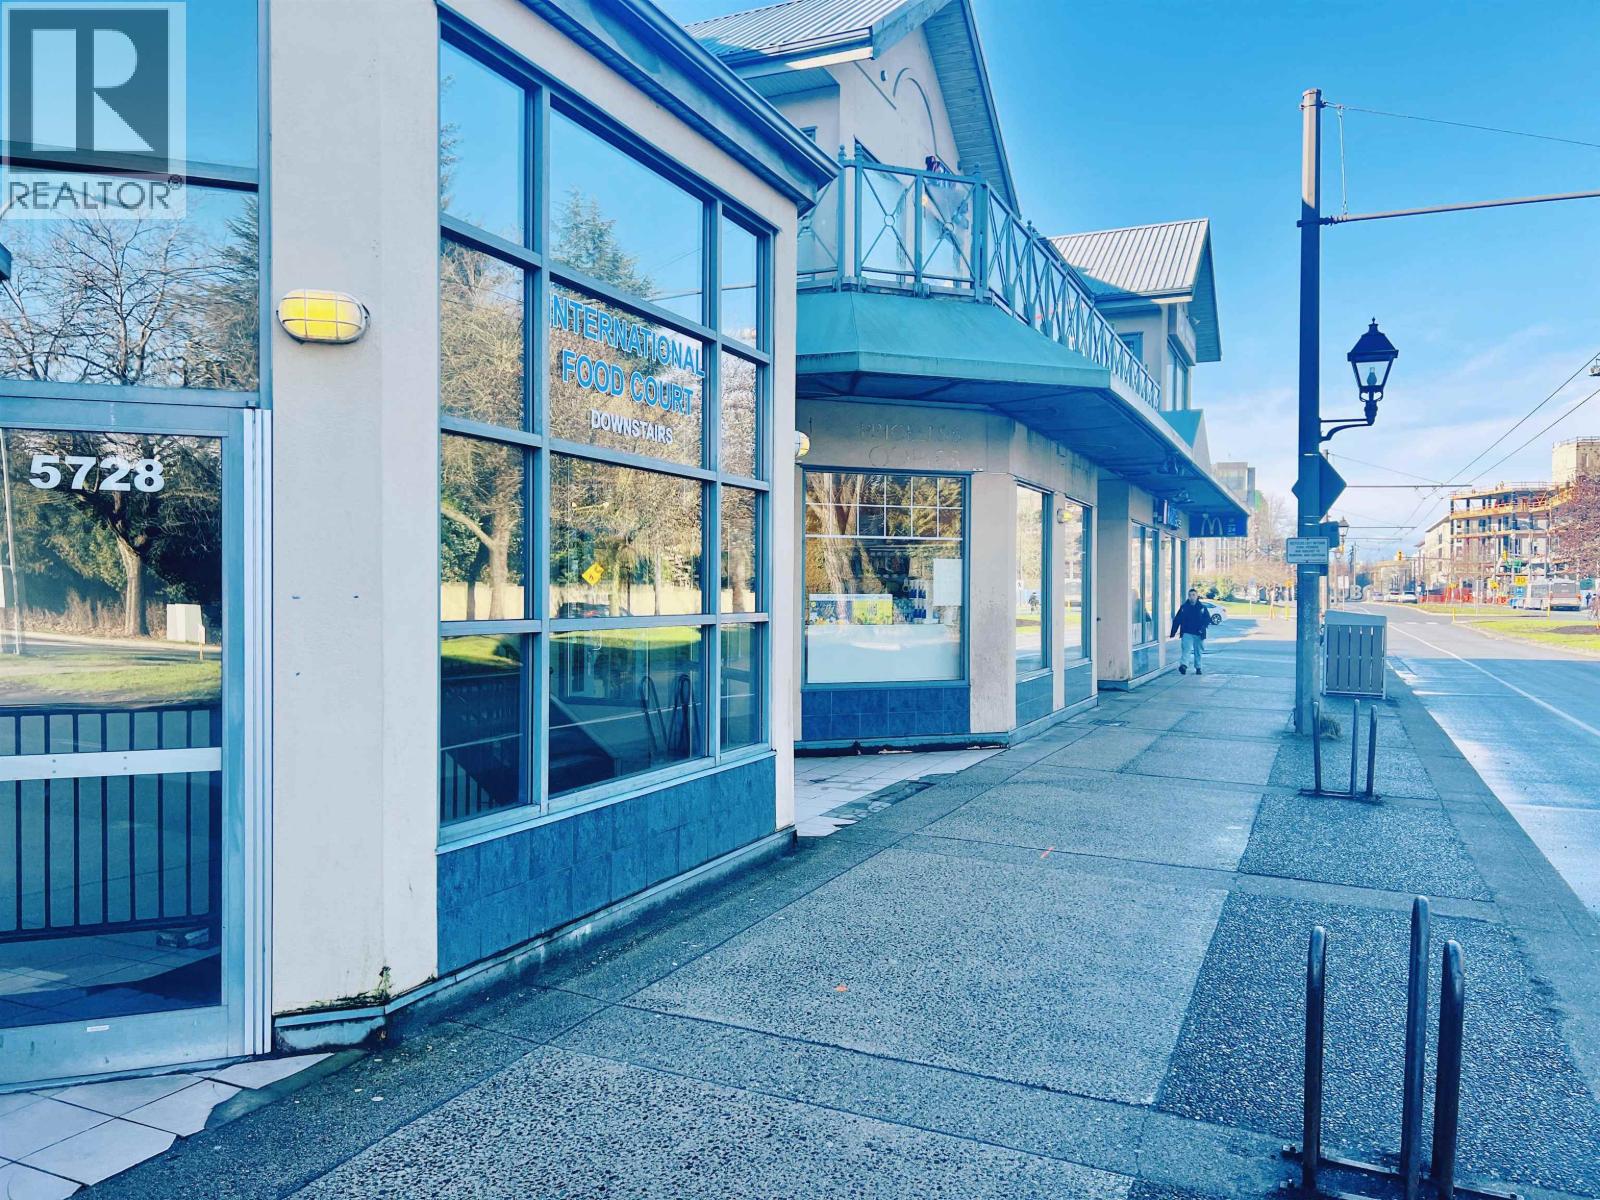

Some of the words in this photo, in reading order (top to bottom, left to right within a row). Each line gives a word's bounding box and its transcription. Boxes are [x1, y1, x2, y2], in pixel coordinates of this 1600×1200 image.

[562, 348, 625, 397] FOOD
[630, 371, 694, 417] COURT
[591, 408, 673, 445] DOWNSTAIRS
[29, 455, 165, 493] 5728
